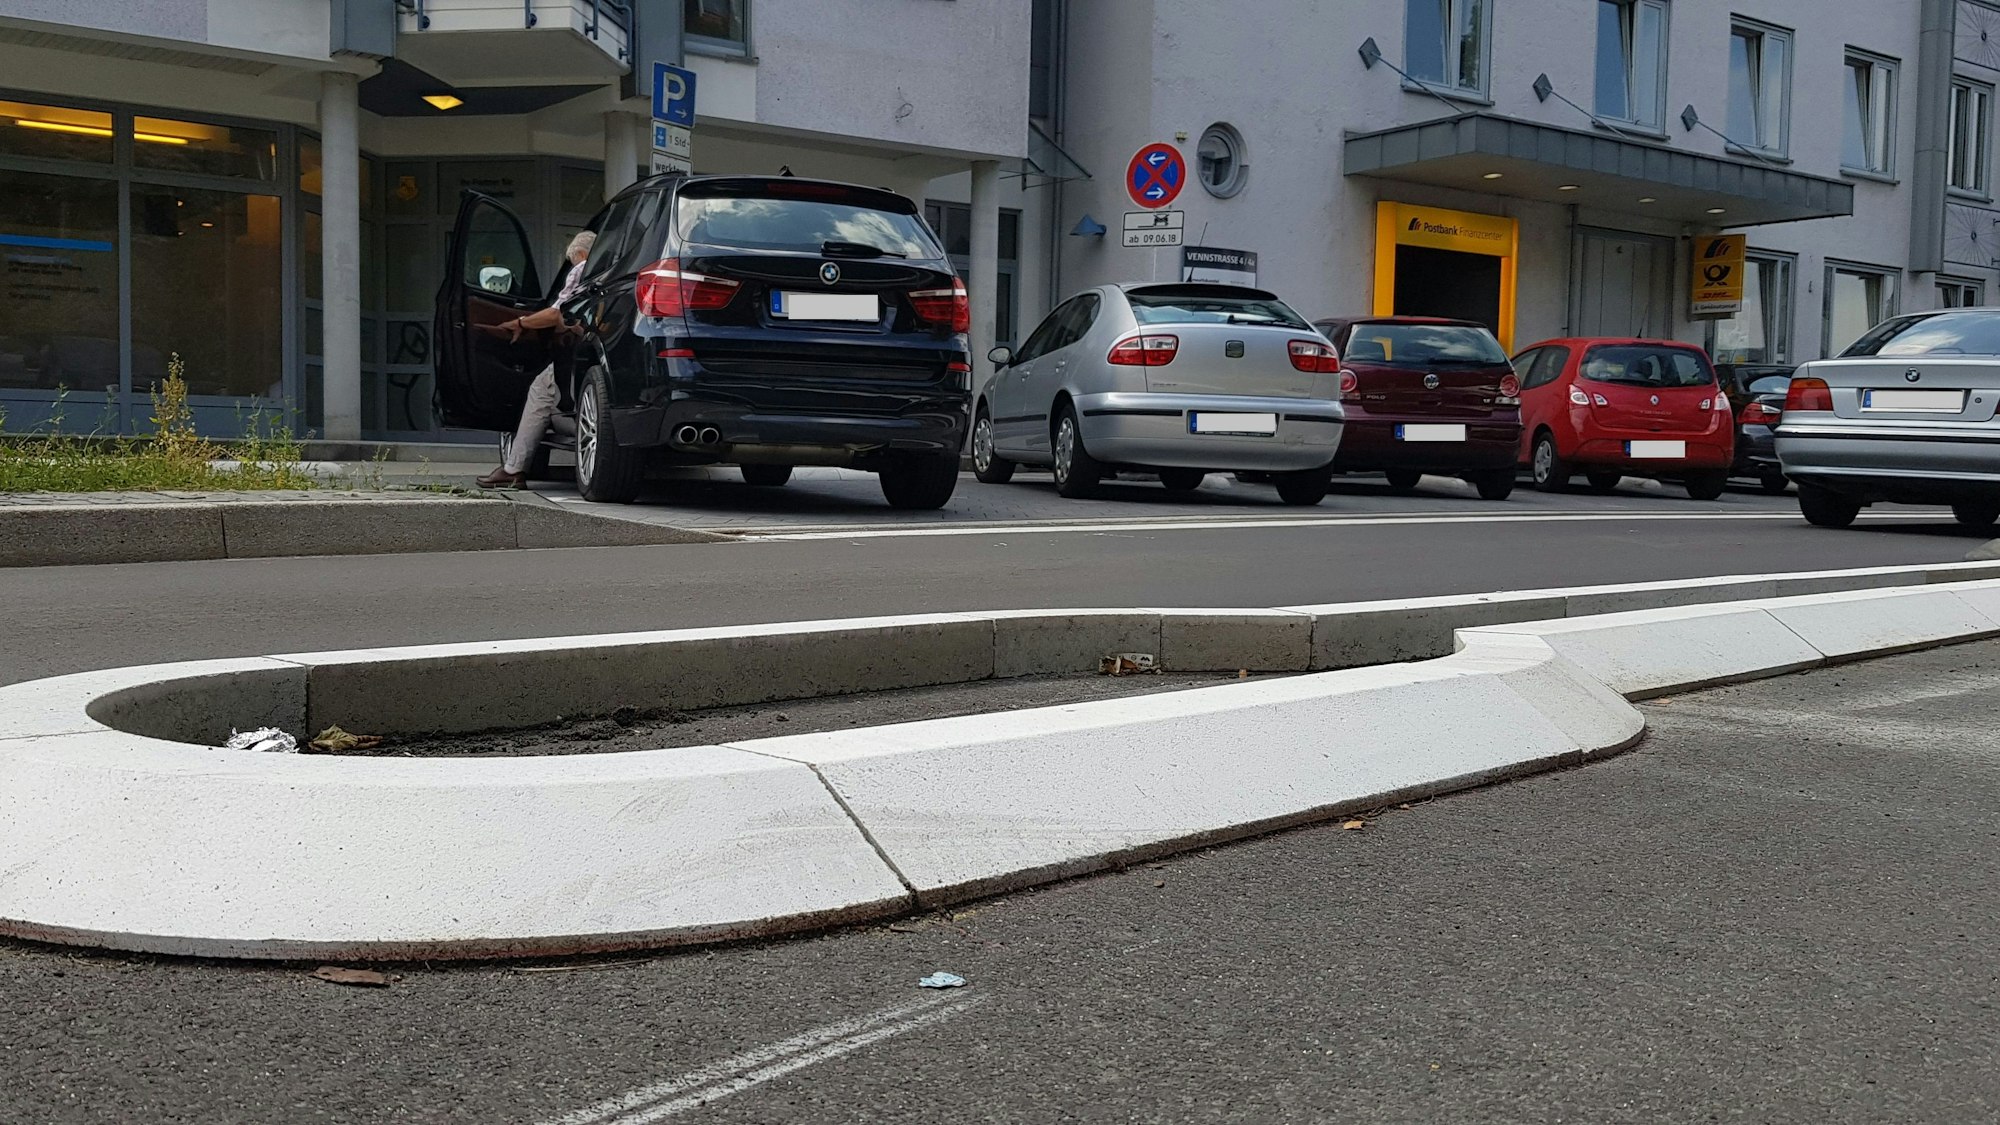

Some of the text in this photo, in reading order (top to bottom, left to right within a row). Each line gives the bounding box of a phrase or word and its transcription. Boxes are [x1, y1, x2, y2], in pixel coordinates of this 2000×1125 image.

[662, 72, 687, 114] P
[1129, 234, 1176, 243] ab 09.06.18
[1423, 222, 1503, 240] Postbank Finanzcenter
[1187, 252, 1238, 264] VENNSTRASSE
